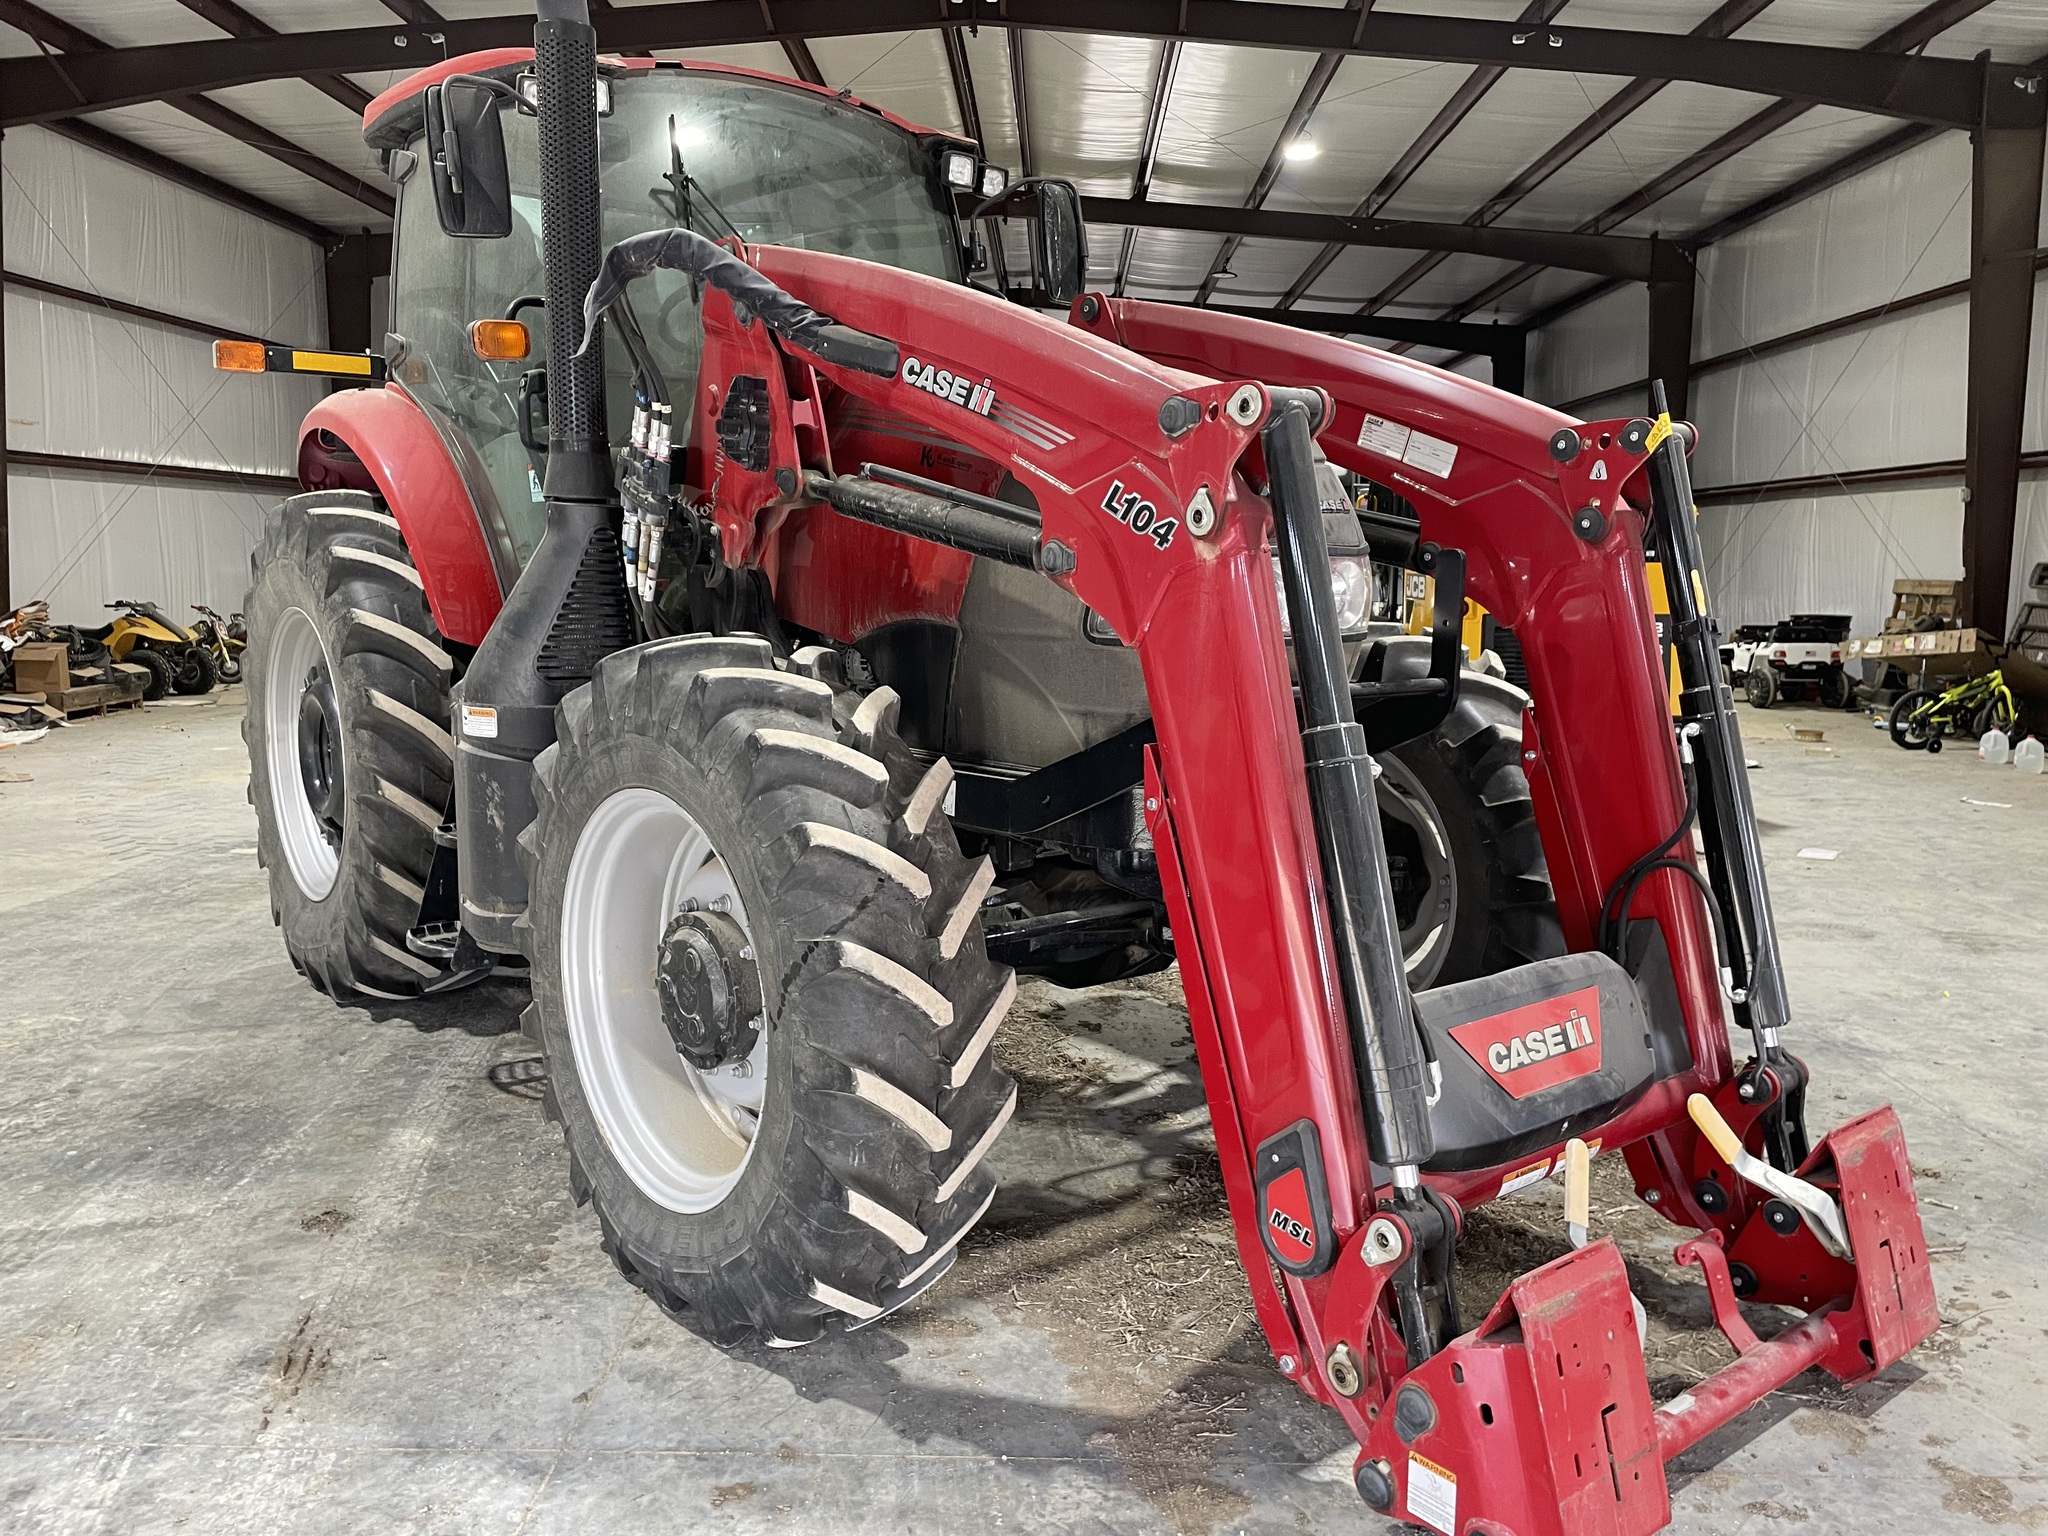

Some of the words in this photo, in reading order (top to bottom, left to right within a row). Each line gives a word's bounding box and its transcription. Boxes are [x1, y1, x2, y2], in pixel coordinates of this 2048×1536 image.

[902, 357, 970, 405] CASE
[1101, 479, 1180, 550] L104
[1406, 574, 1426, 599] JCB
[1488, 1025, 1562, 1074] CASE
[1270, 1209, 1313, 1248] MSL
[1419, 1458, 1455, 1483] WARNING
